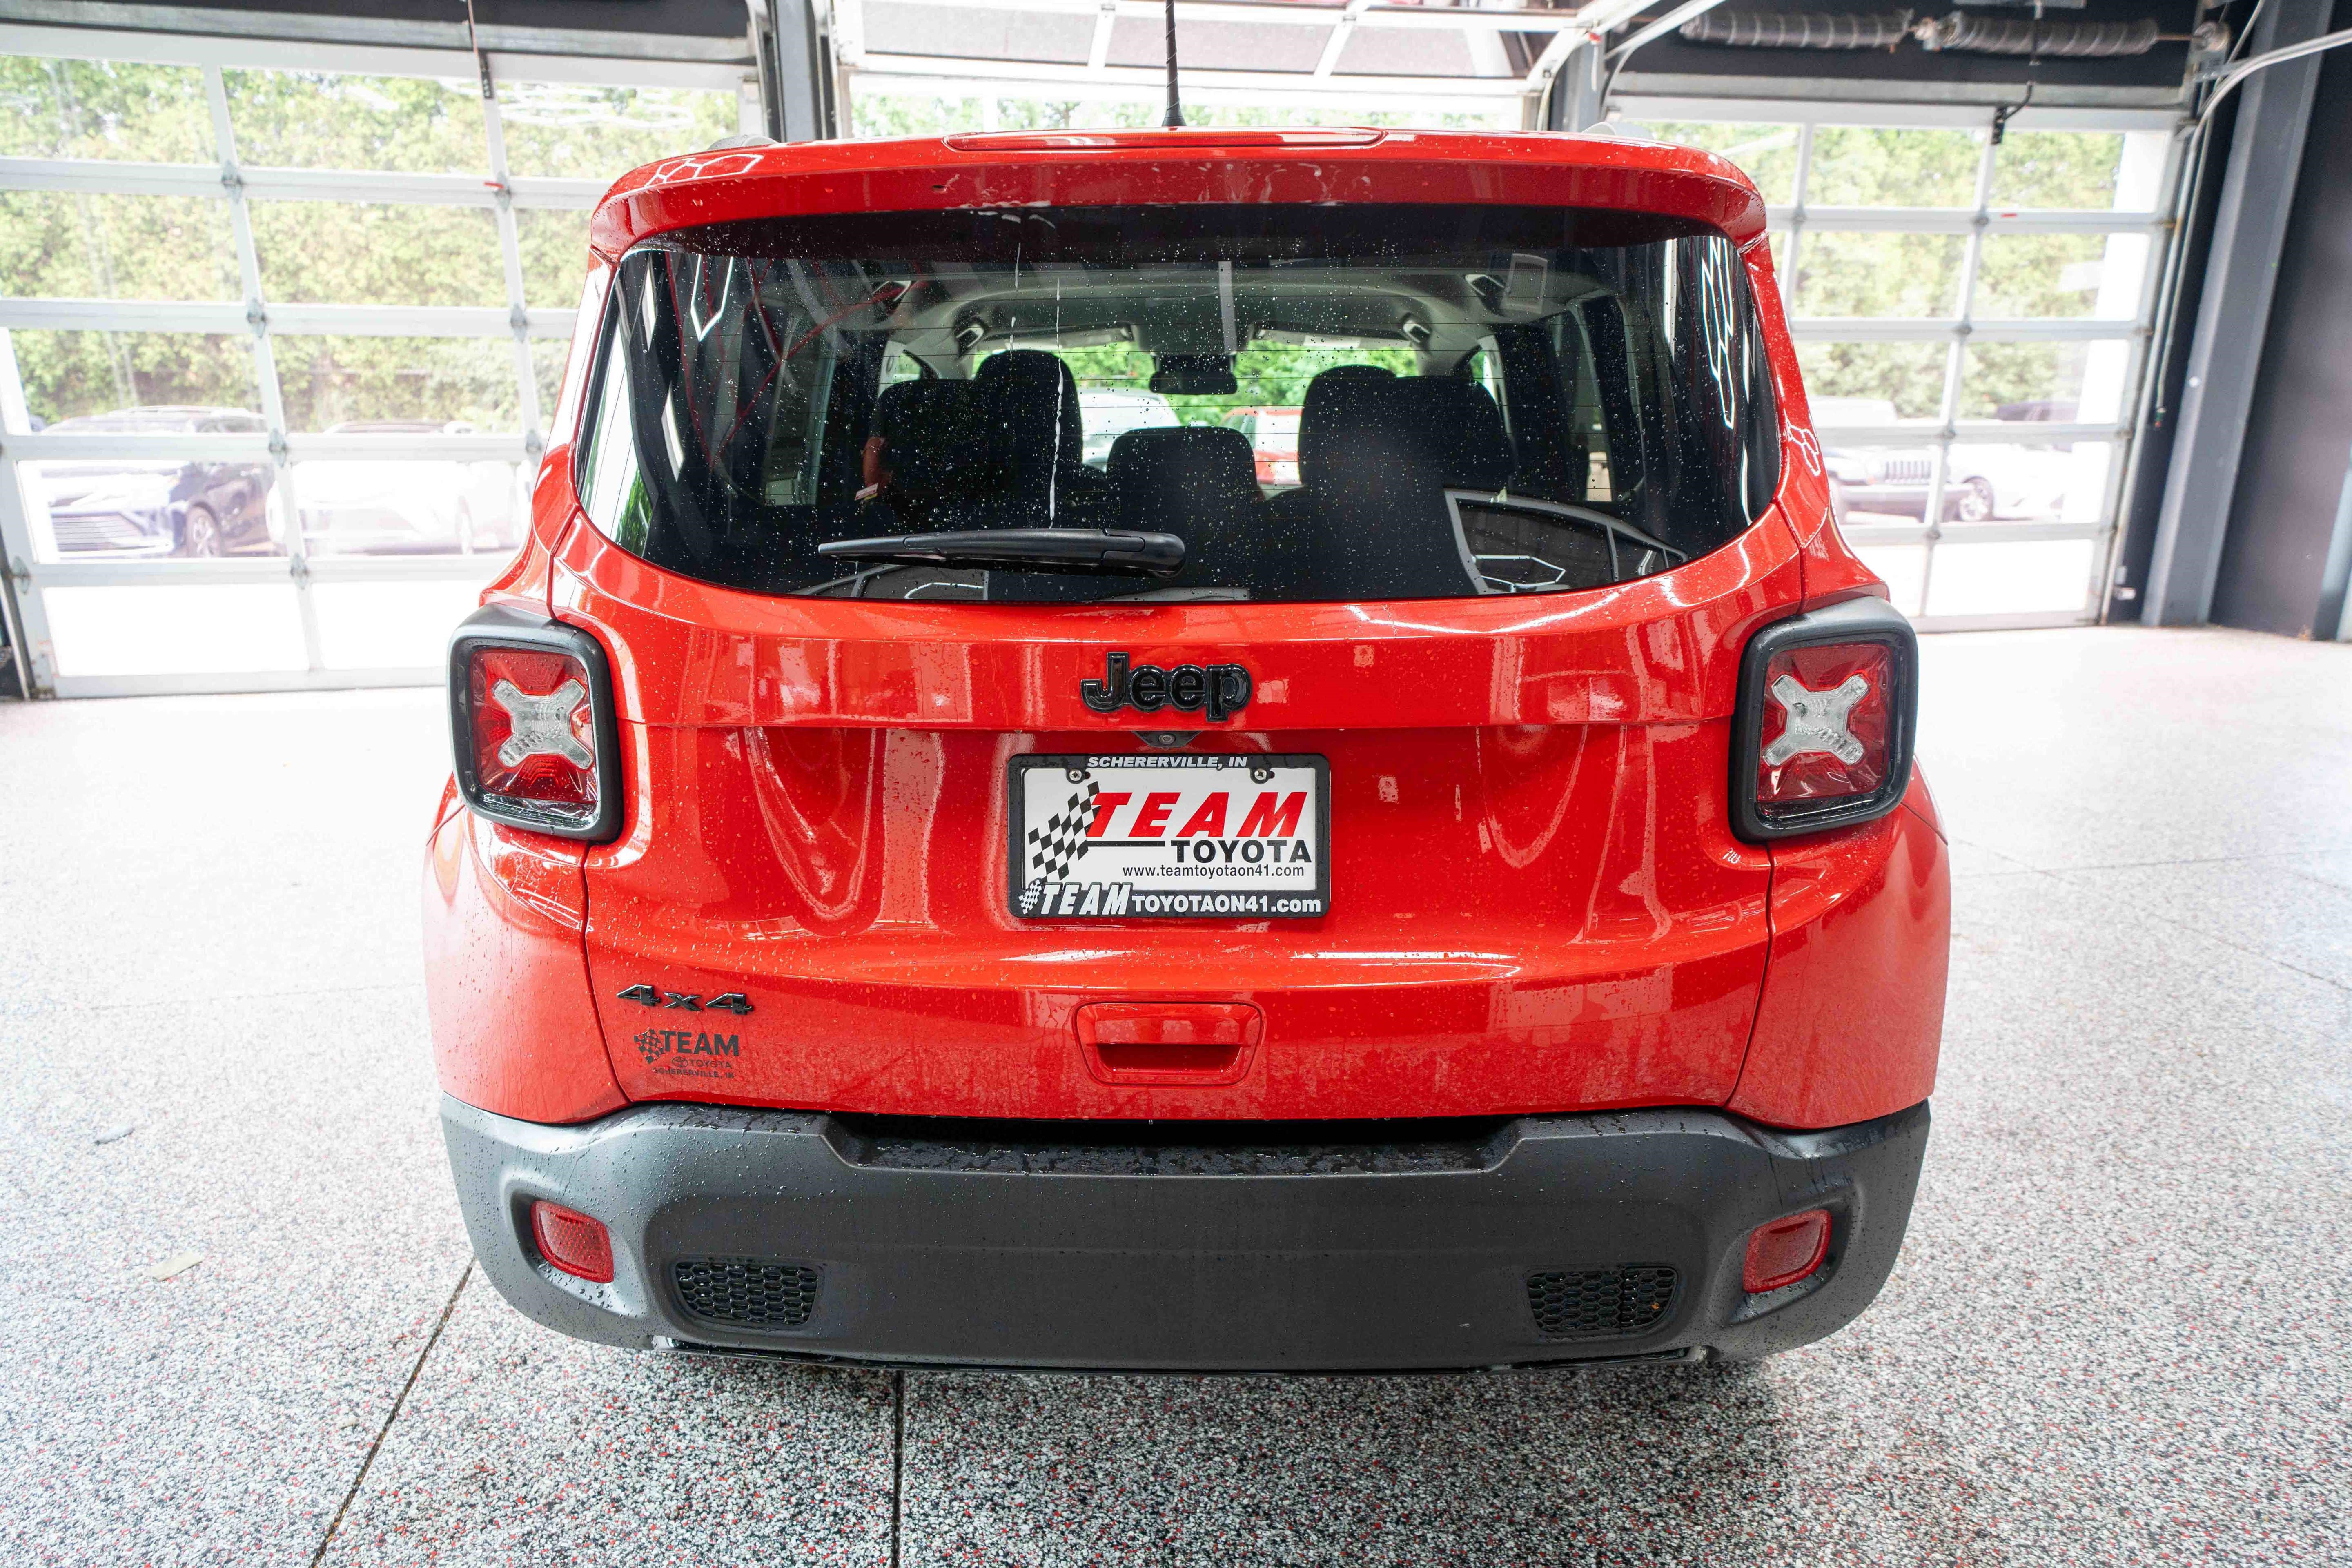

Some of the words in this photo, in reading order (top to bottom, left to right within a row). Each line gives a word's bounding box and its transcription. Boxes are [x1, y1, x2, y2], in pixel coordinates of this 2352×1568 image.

[1080, 652, 1252, 722] Jeep
[1088, 757, 1223, 770] SCHERERVILLE,
[1228, 757, 1247, 767] IN
[1086, 792, 1307, 837] TEAM
[1171, 840, 1312, 863] TOYOTA
[1123, 864, 1304, 879] www.teamtoyotaon41.com
[1041, 884, 1131, 915] TEAM
[1131, 895, 1321, 913] TOYOTAON41.com
[616, 984, 754, 1015] 4x4
[659, 1030, 739, 1056] TEAM
[689, 1059, 732, 1069] TOYOTA
